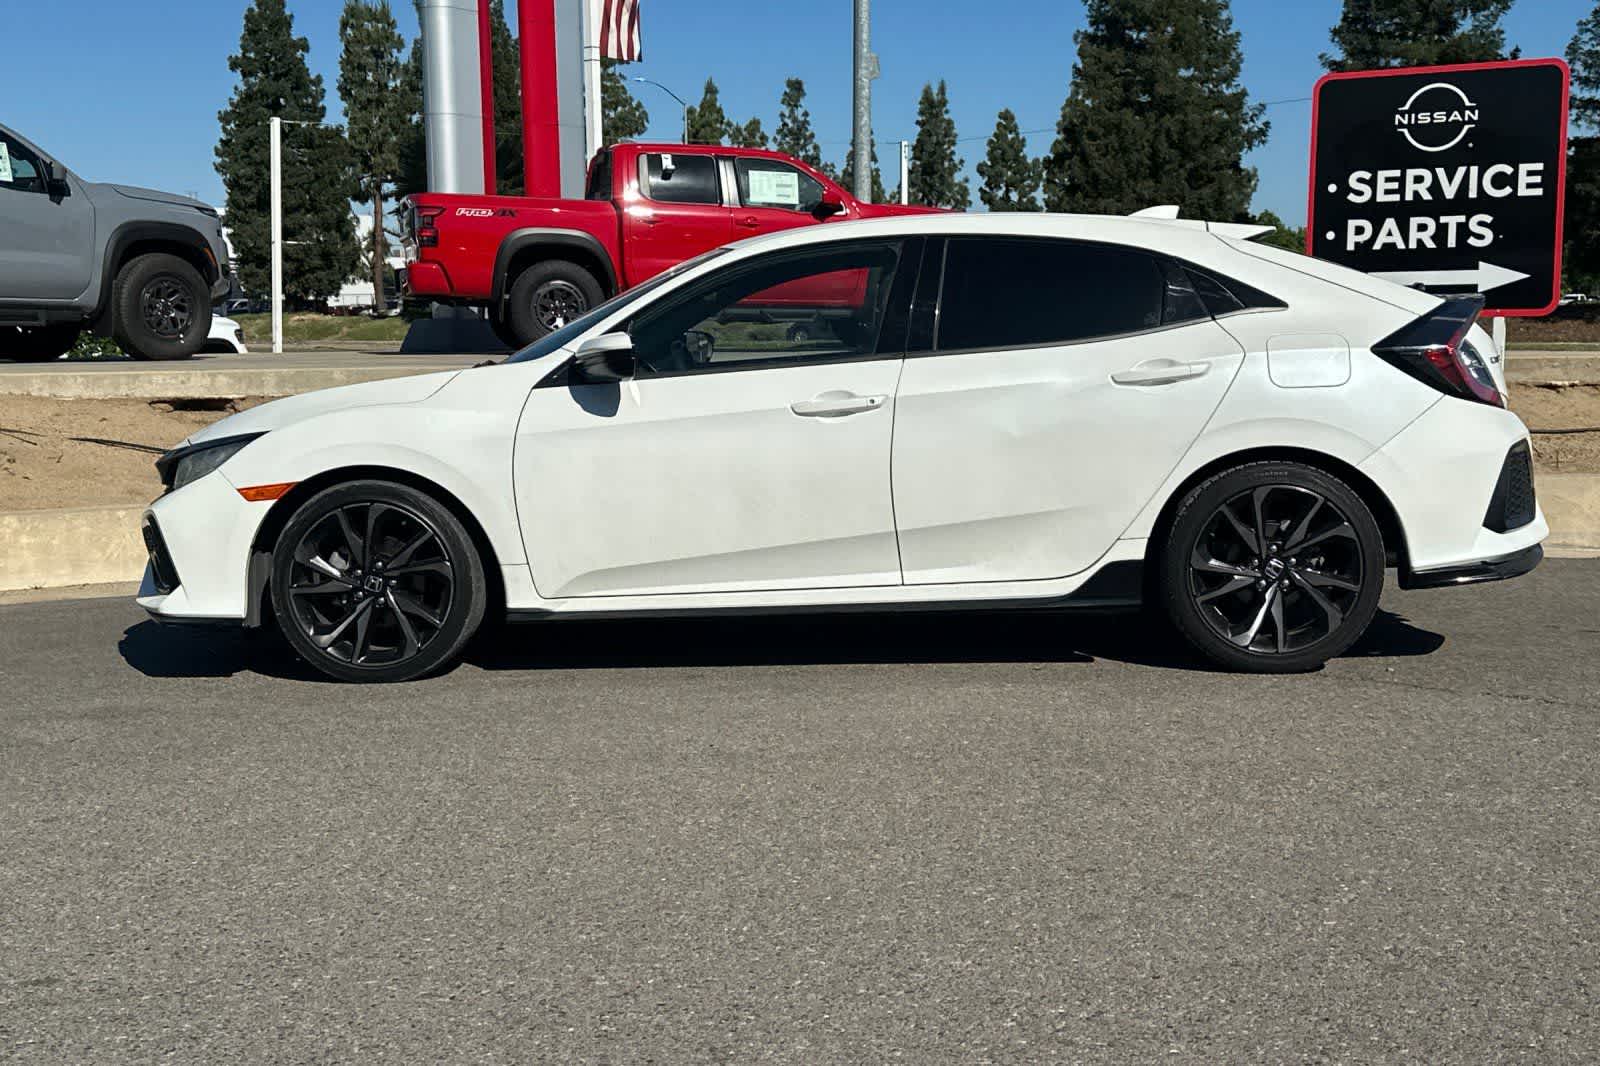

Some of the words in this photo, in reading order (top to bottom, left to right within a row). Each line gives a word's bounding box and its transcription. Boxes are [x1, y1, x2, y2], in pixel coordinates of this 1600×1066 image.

[1394, 109, 1479, 126] NISSAN
[1346, 162, 1545, 204] SERVICE
[1345, 213, 1495, 251] PARTS
